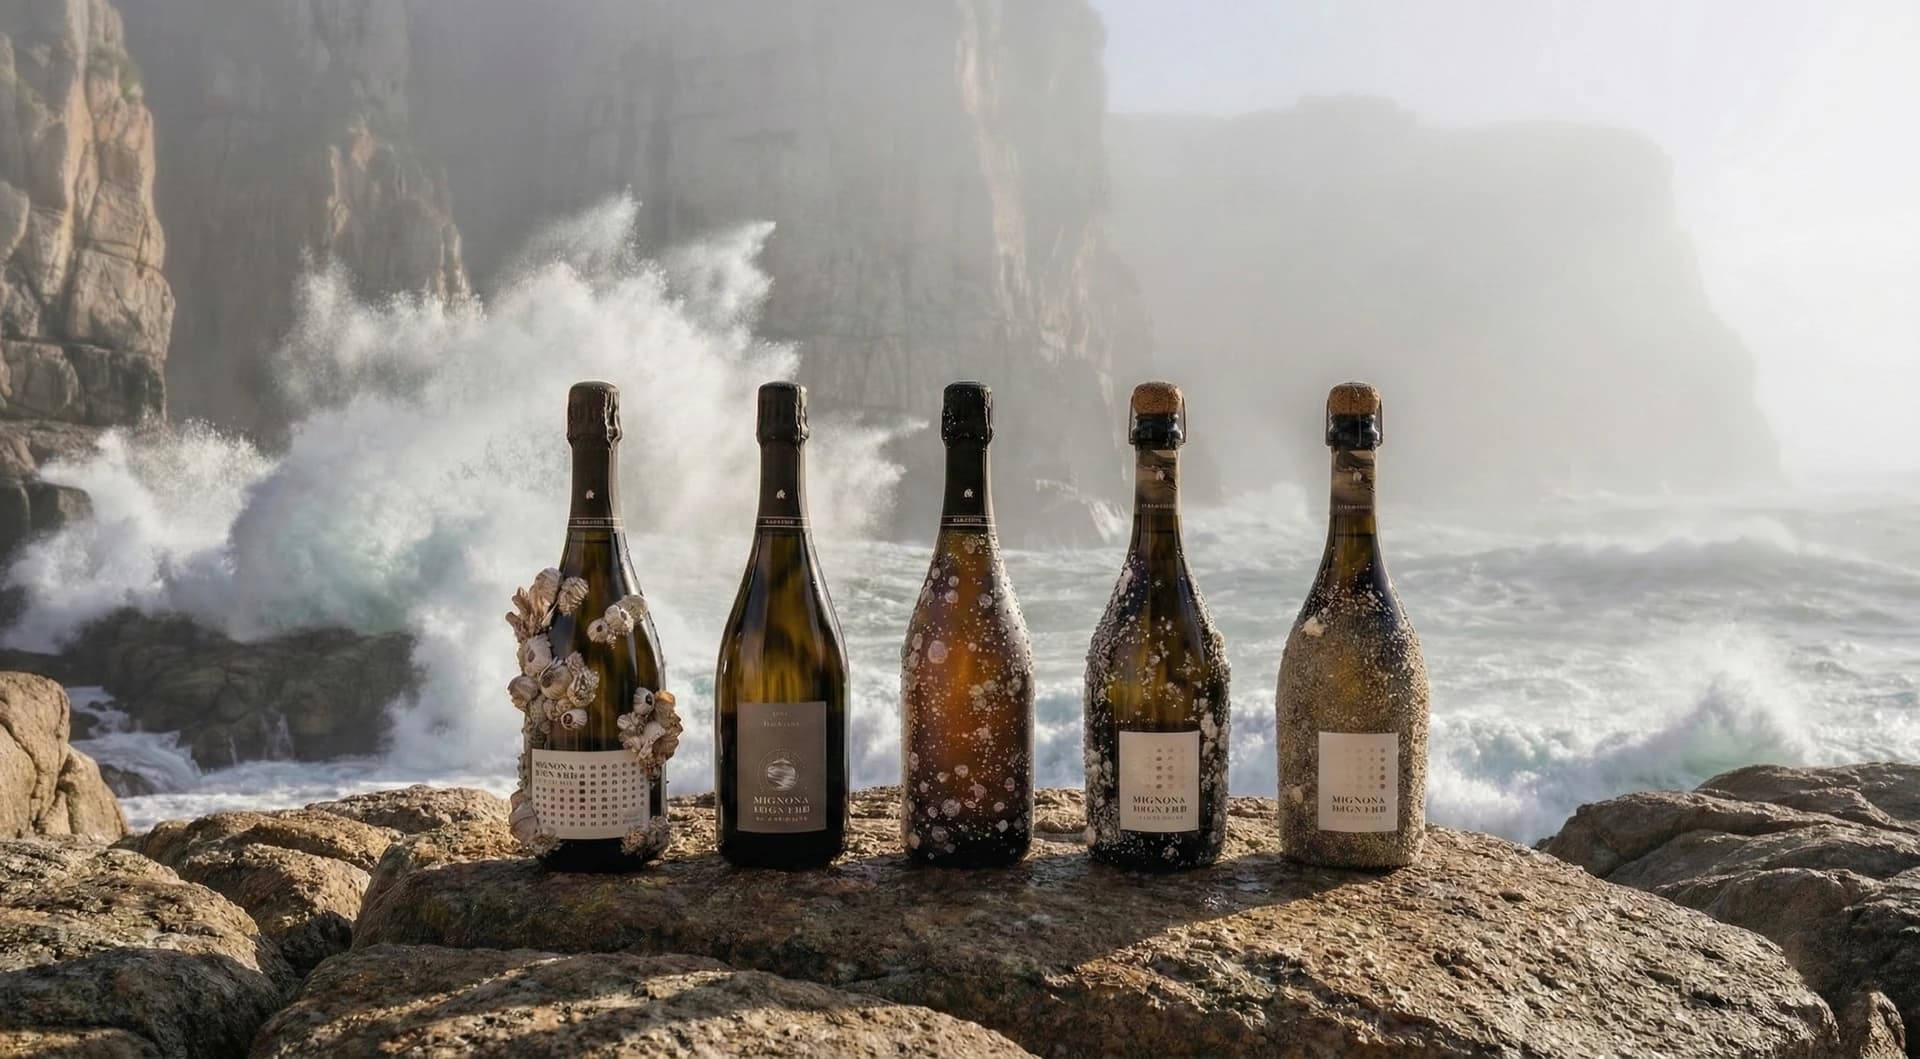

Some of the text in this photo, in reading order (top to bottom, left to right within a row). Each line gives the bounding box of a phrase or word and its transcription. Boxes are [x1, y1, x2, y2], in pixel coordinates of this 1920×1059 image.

[753, 796, 809, 804] MIGNONA
[1132, 796, 1186, 804] MIGNONA
[1331, 796, 1385, 804] MIGNONA
